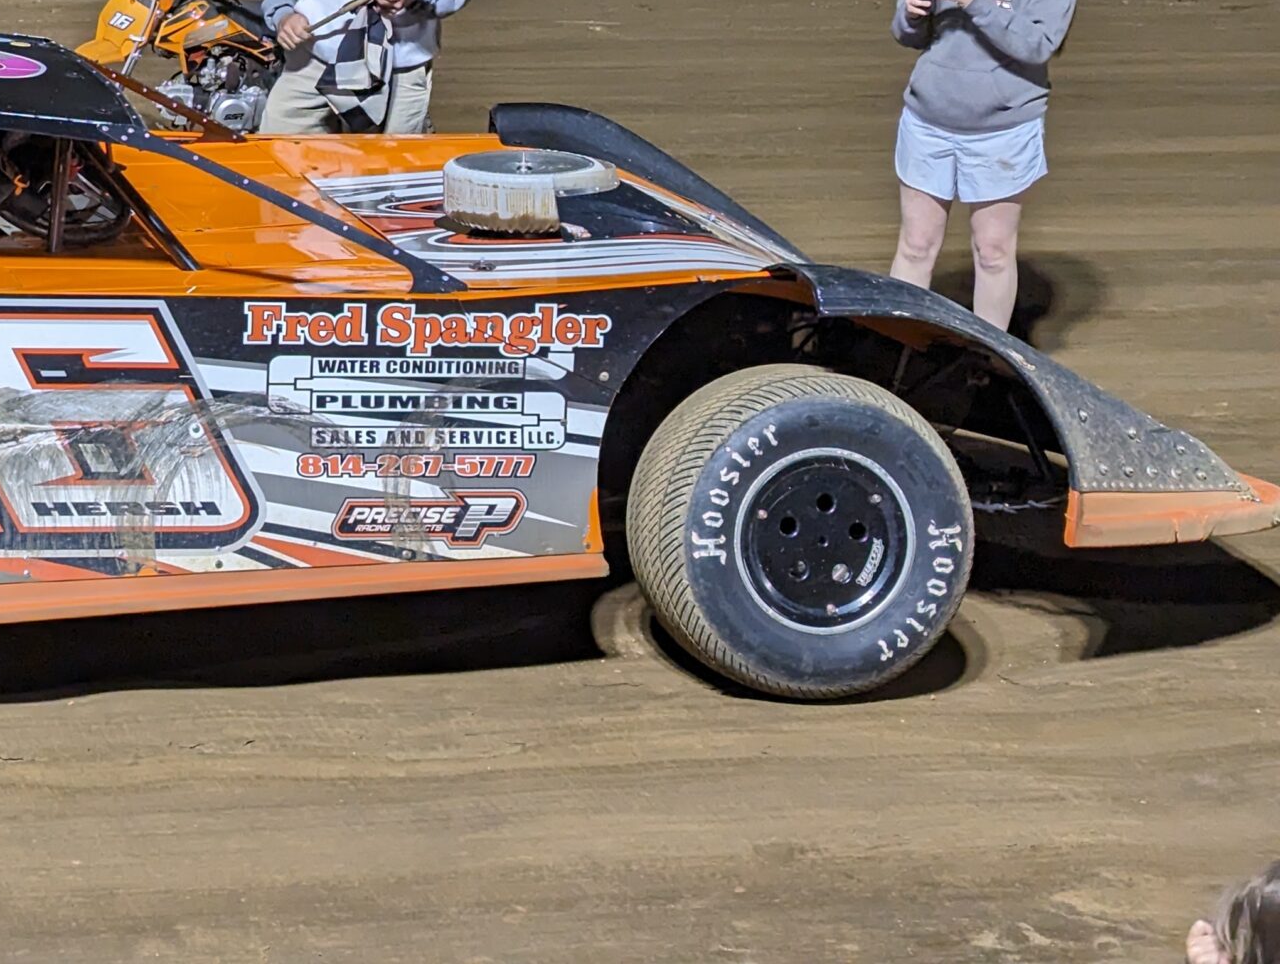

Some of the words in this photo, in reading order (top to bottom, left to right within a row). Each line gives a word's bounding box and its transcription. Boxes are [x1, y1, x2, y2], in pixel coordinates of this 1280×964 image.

[109, 11, 135, 30] 16
[245, 302, 367, 345] Fred
[377, 303, 610, 356] Spangler
[317, 358, 380, 375] WATER
[385, 358, 520, 376] CONDITIONING
[315, 395, 519, 410] PLUMBING
[315, 429, 377, 445] SALES
[386, 429, 426, 446] AND
[435, 430, 519, 446] SERVICE
[528, 430, 561, 445] LLC.
[297, 453, 536, 478] 814-267-5777
[692, 424, 778, 565] Hoosier
[31, 501, 222, 516] HERSH
[347, 506, 461, 525] PRECISE
[354, 524, 392, 532] RACING
[878, 519, 963, 662] Hoosier
